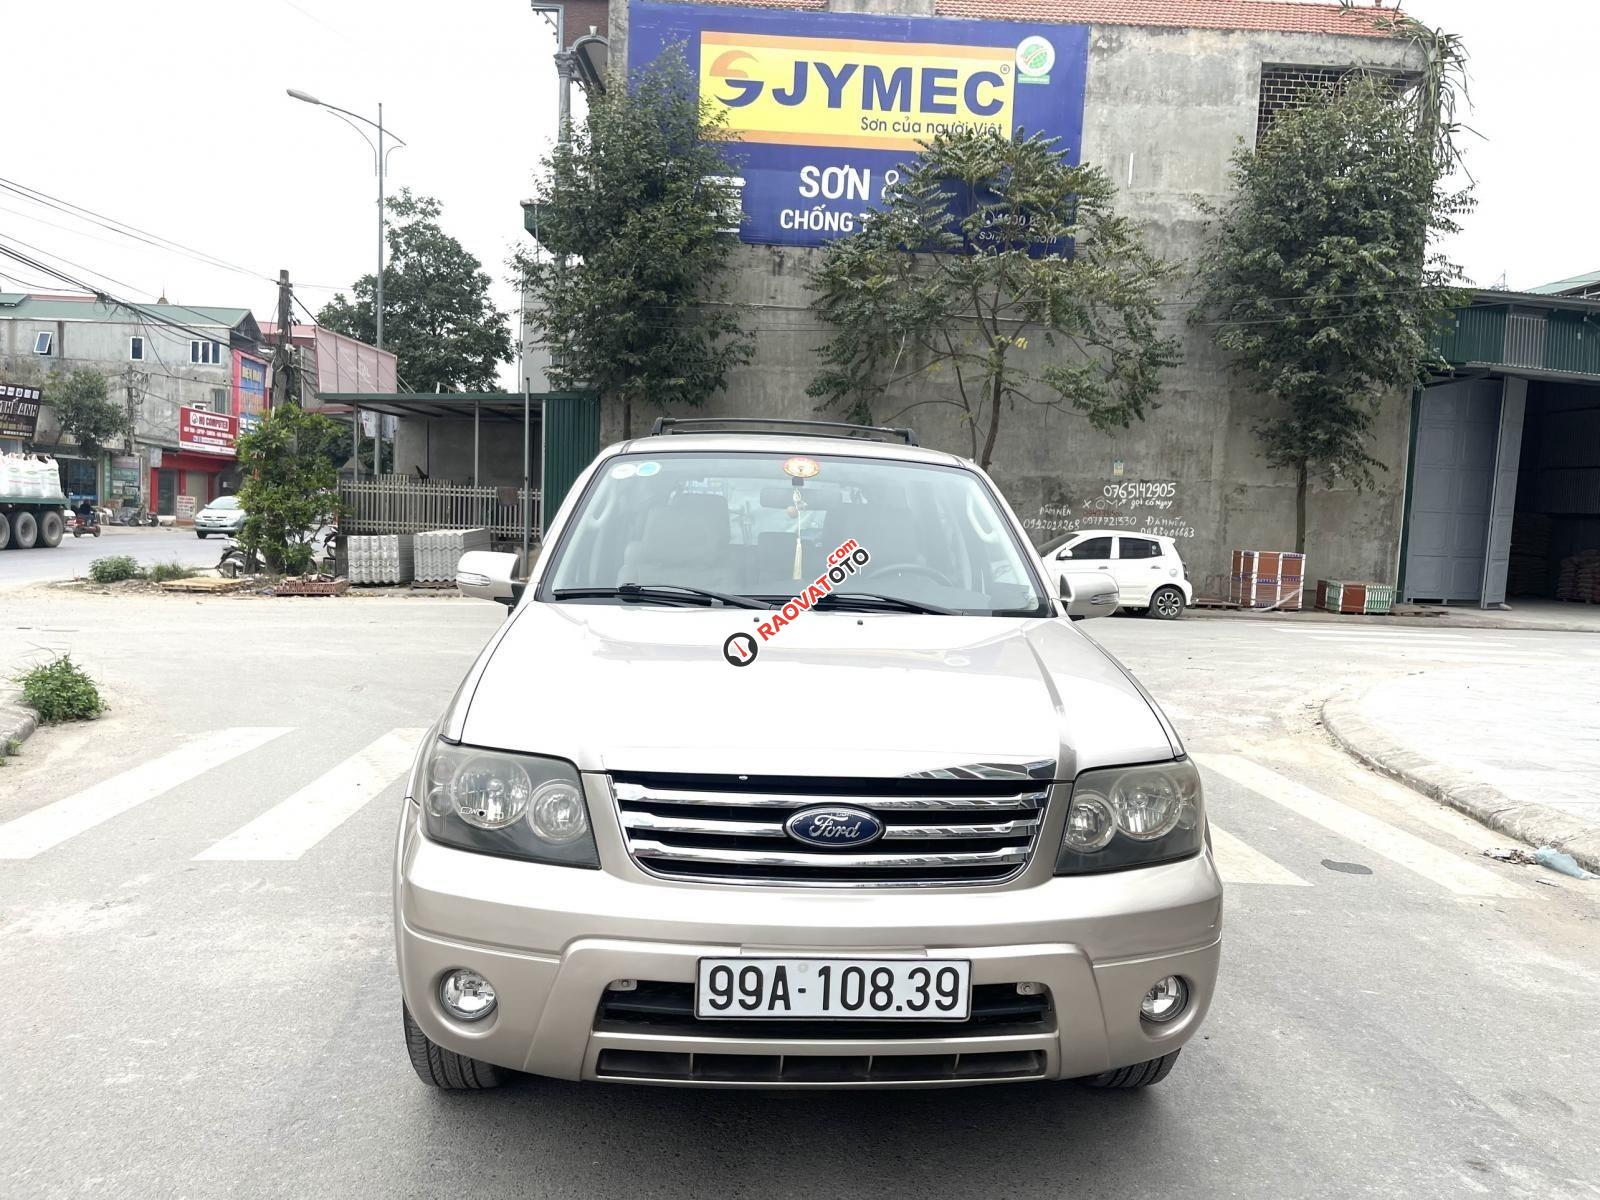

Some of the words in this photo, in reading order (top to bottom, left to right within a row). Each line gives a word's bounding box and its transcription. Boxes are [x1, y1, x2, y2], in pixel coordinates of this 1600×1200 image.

[772, 61, 1005, 116] JYMEC
[861, 116, 887, 131] Sơn
[892, 116, 921, 133] của
[799, 164, 870, 200] SƠN
[780, 204, 854, 232] CHỐNG
[1103, 482, 1176, 498] 0765142905
[809, 815, 862, 838] Ford
[709, 965, 960, 1012] 99A-108.39
